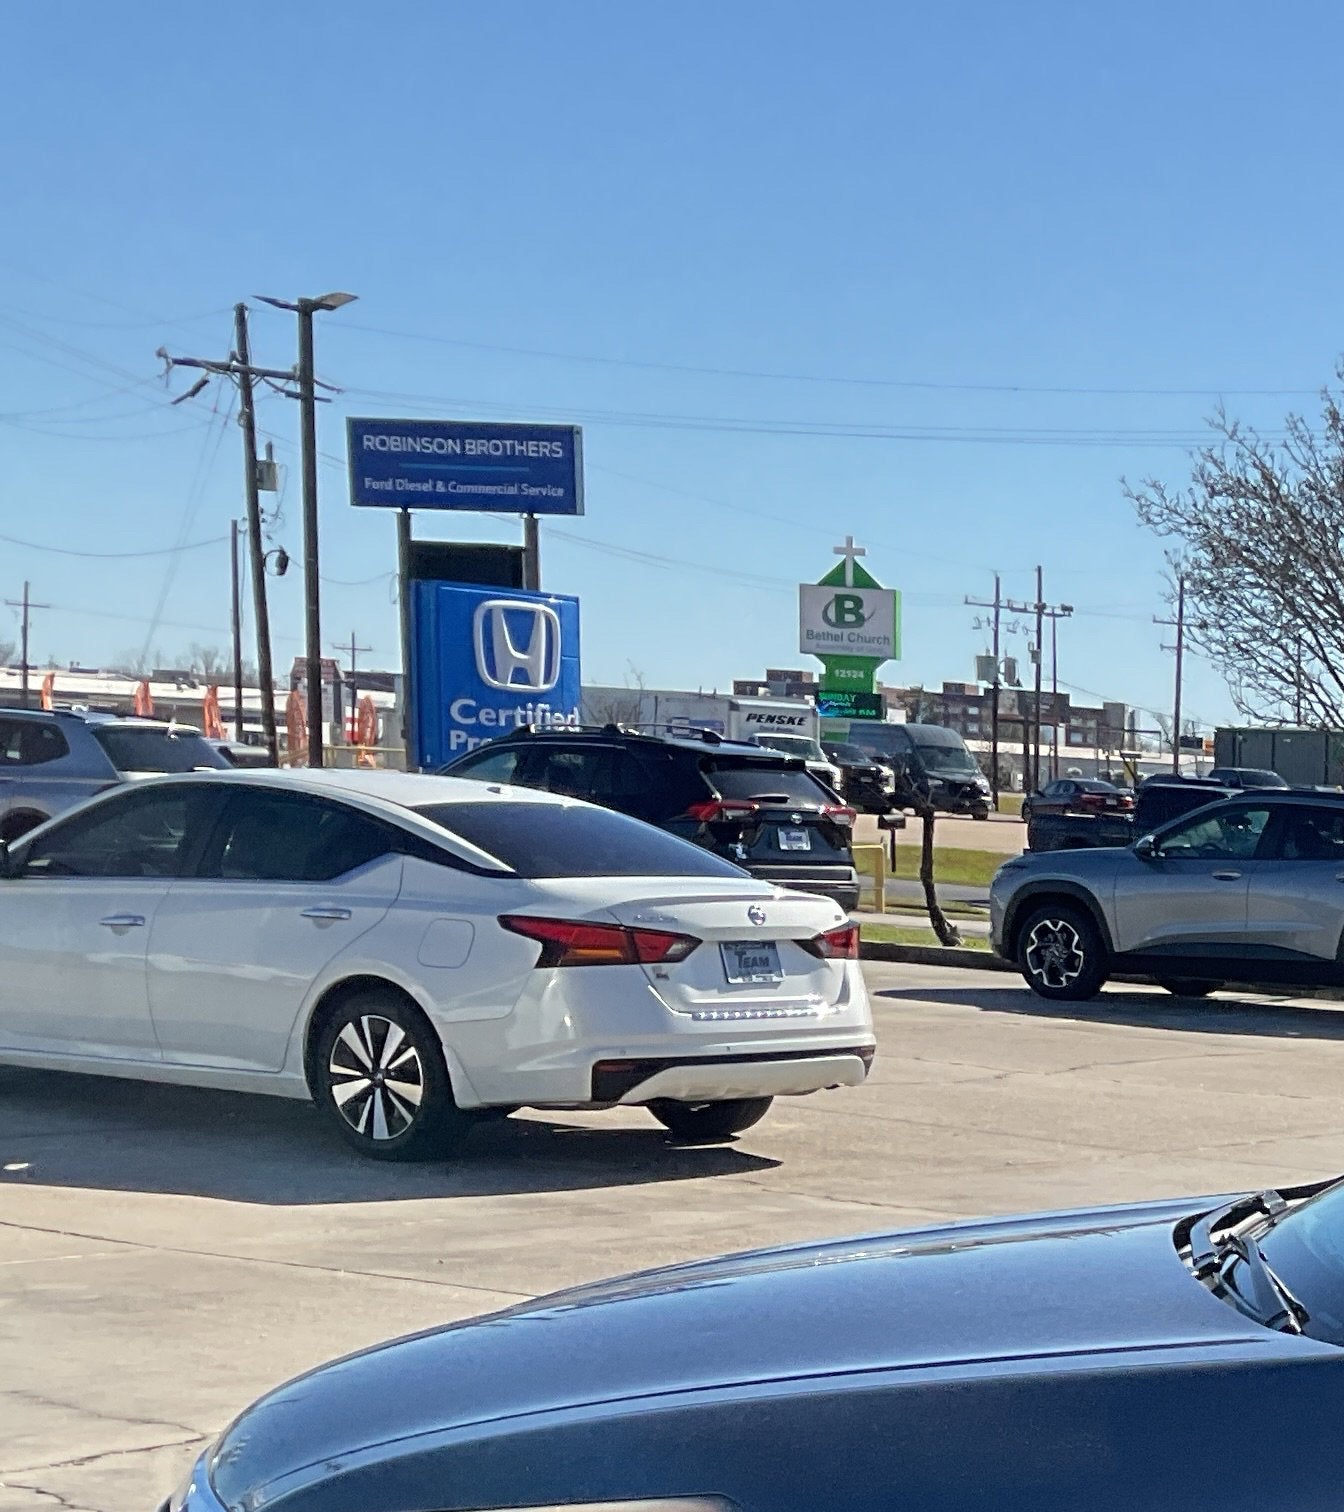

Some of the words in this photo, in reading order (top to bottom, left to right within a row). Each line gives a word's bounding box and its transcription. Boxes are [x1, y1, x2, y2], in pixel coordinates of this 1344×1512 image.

[363, 434, 460, 454] ROBINSON
[465, 438, 563, 458] BROTHERS
[364, 477, 393, 491] Ford
[396, 478, 432, 492] Diesel
[436, 480, 445, 493] &
[448, 481, 517, 495] Commercial
[520, 483, 564, 497] Service
[834, 593, 866, 628] B
[806, 629, 844, 642] Bethel
[847, 631, 890, 645] Church
[450, 698, 582, 732] Certified
[746, 712, 807, 726] PENSKE
